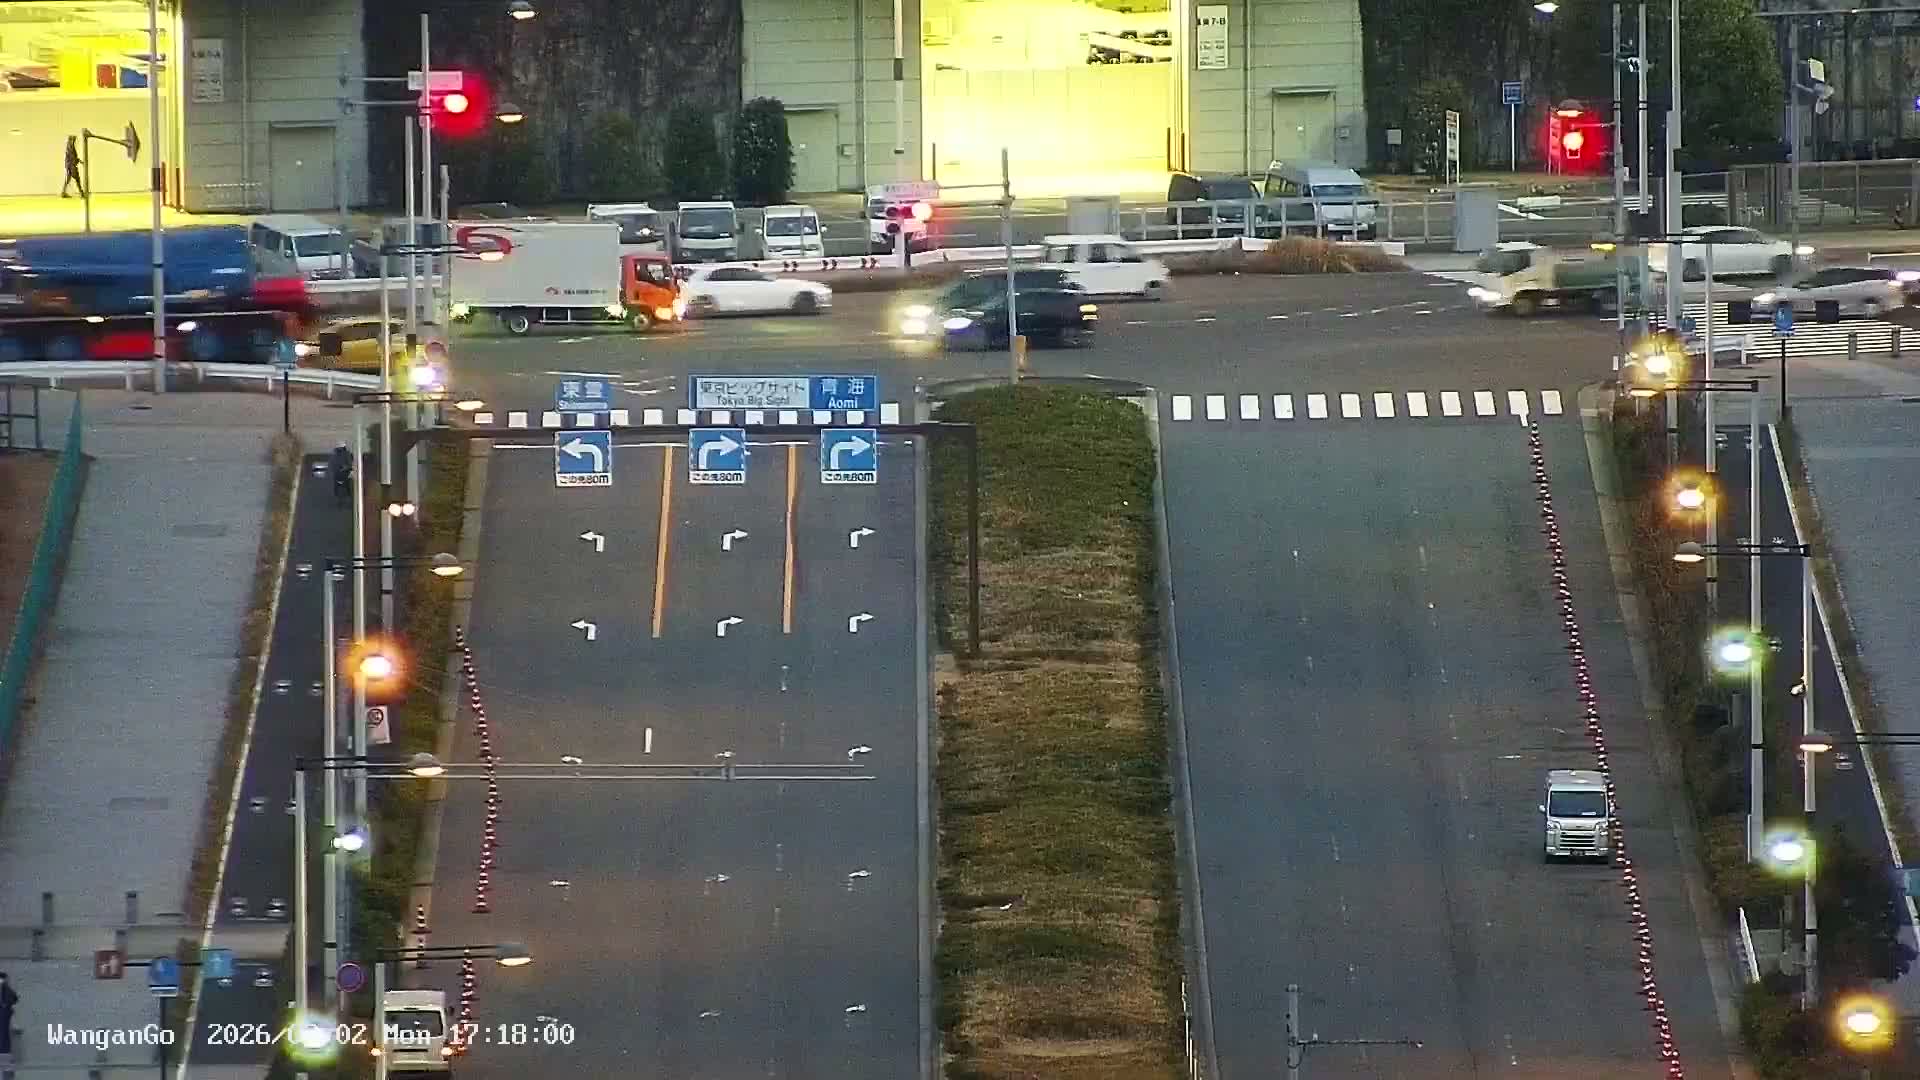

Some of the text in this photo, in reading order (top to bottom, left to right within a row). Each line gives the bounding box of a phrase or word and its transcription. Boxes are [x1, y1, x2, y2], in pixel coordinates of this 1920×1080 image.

[821, 377, 865, 395] 青海
[717, 395, 790, 406] Tokyo Big Sight
[828, 397, 858, 408] Aomi
